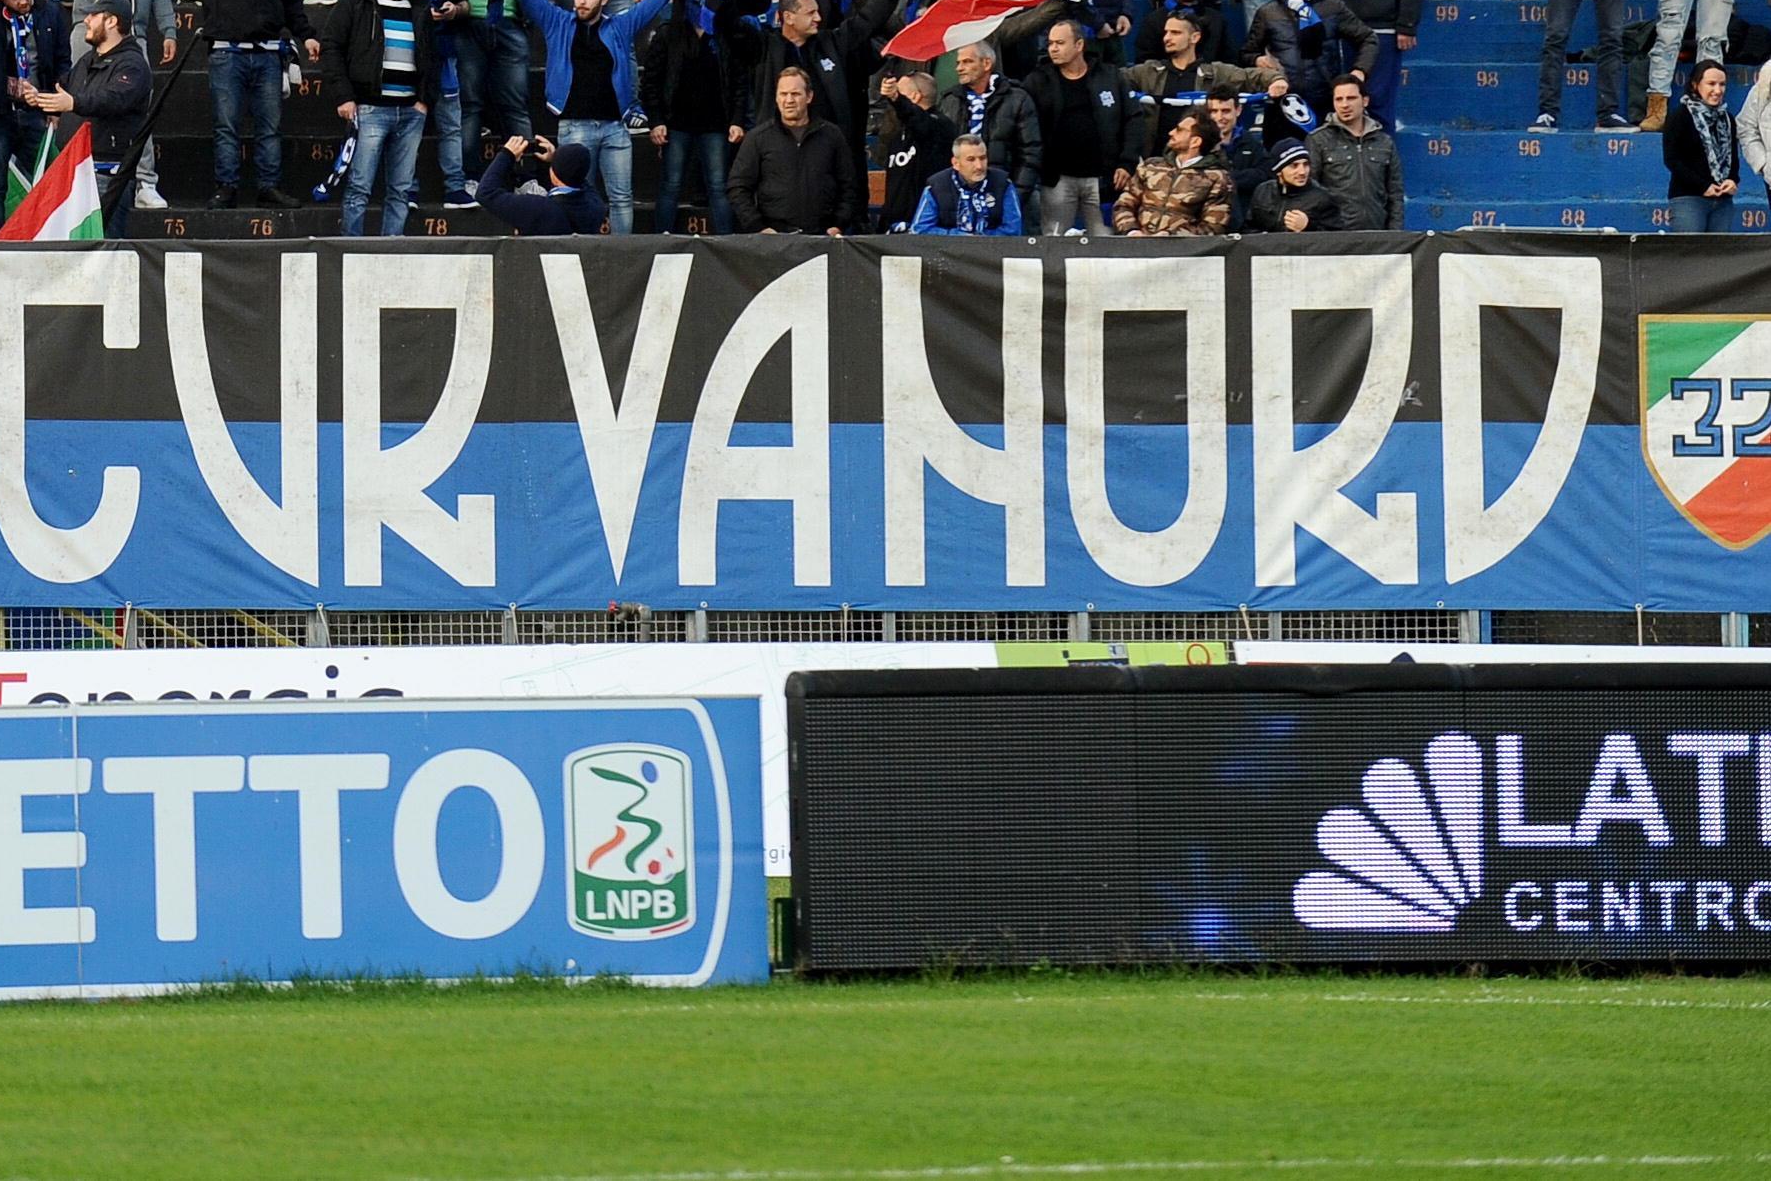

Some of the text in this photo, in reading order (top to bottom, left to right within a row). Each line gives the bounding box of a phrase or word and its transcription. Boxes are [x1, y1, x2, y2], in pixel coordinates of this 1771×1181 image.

[1435, 5, 1459, 22] 99
[1477, 71, 1499, 87] 98
[1565, 69, 1590, 86] 99
[298, 80, 323, 96] 87
[1428, 139, 1451, 156] 95
[1518, 139, 1541, 157] 96
[164, 218, 186, 236] 75
[687, 216, 709, 234] 81
[1561, 209, 1586, 227] 88
[1741, 210, 1766, 228] 90
[250, 219, 273, 236] 76
[425, 219, 448, 236] 78
[1670, 377, 1771, 457] 32
[585, 888, 677, 920] LNPB
[1504, 880, 1771, 932] CENTRO
